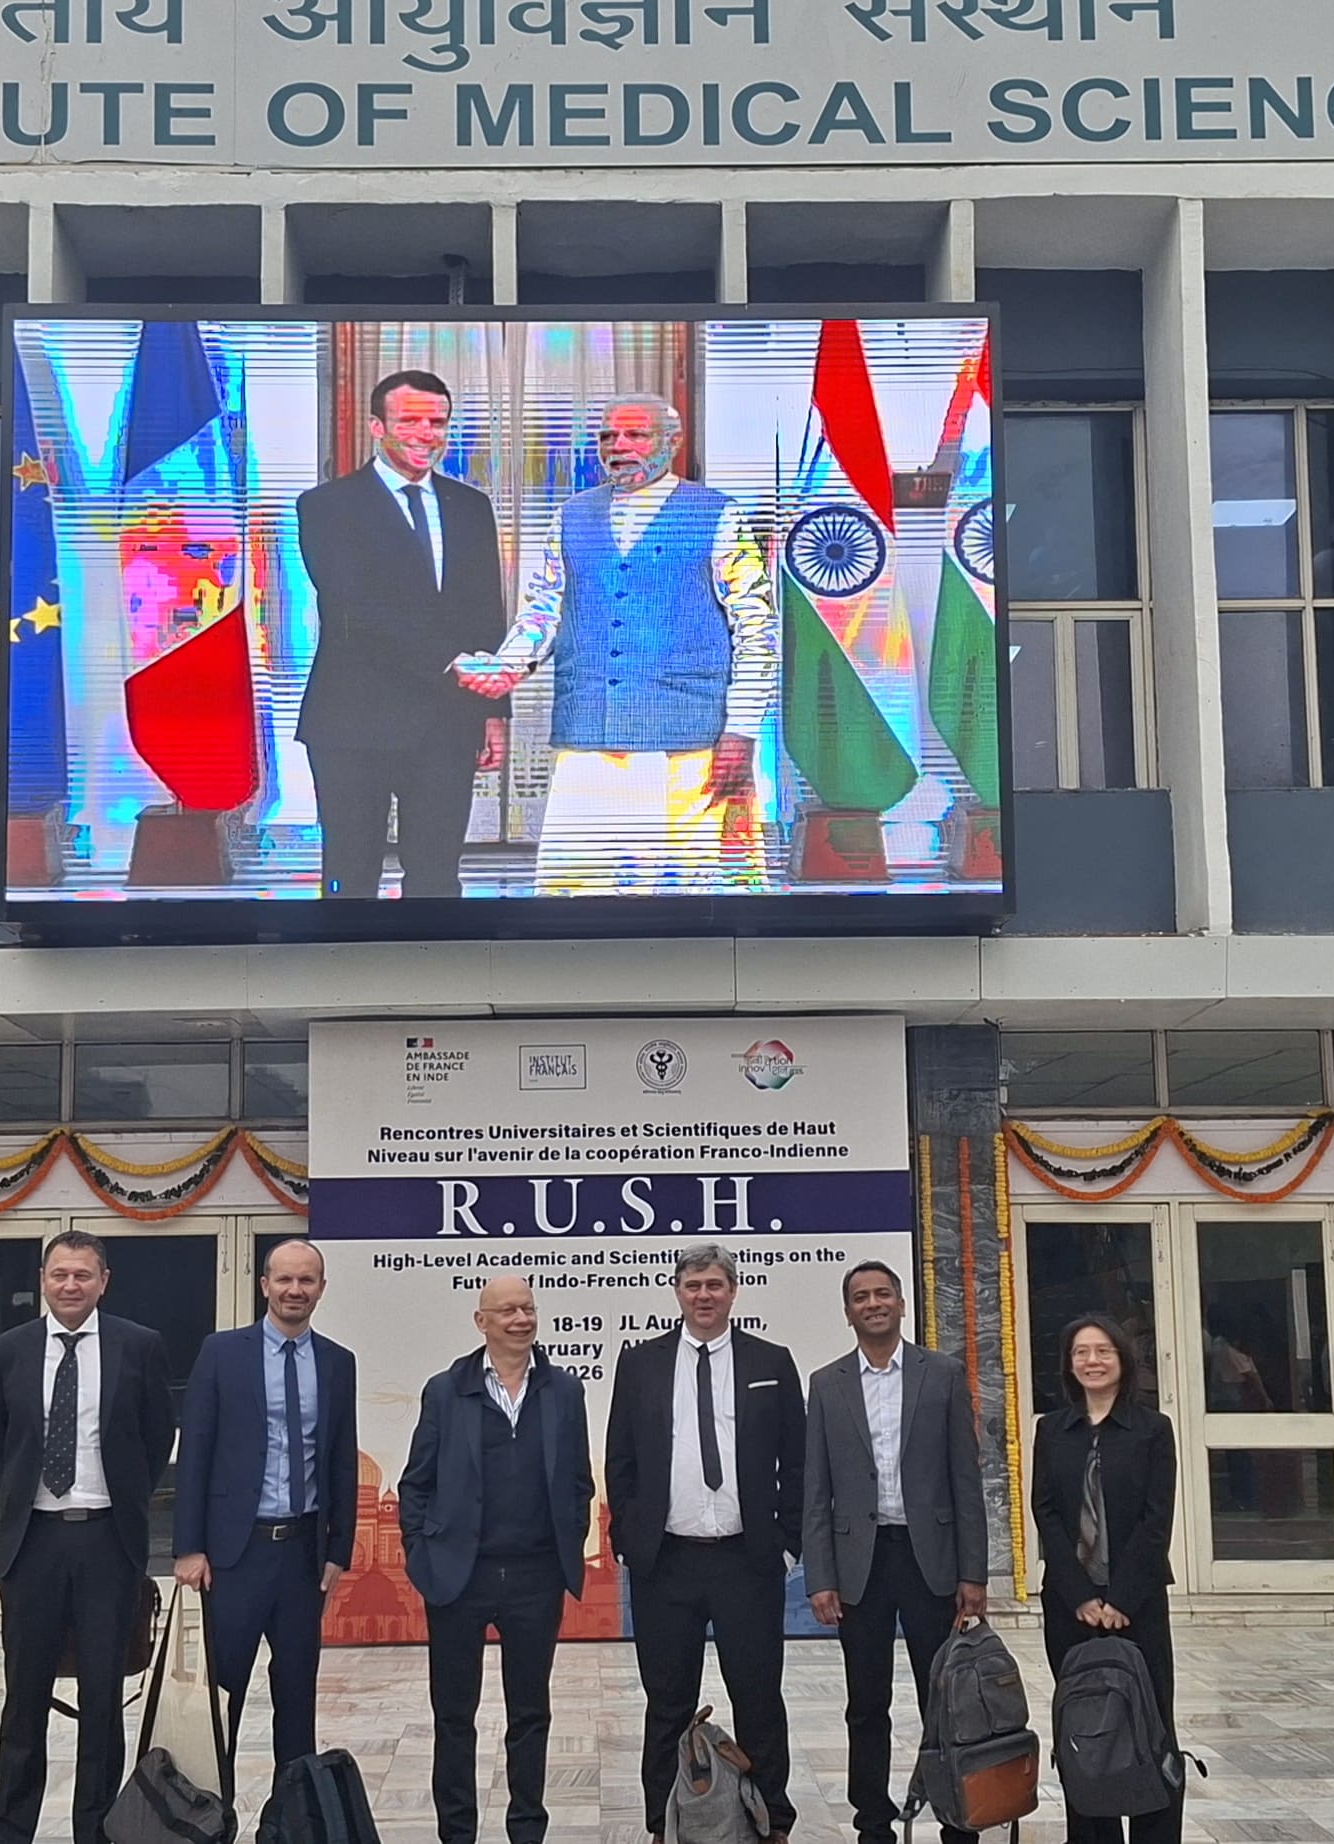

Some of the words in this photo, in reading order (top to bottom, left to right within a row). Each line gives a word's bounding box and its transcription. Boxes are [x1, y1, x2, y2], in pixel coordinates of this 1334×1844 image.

[267, 82, 412, 147] OF
[454, 82, 952, 147] MEDICAL
[406, 1052, 469, 1061] AMBASSADE
[529, 1055, 572, 1066] INSTITUT
[406, 1062, 420, 1071] DE
[423, 1062, 464, 1071] FRANCE
[529, 1063, 577, 1077] FRANÇAIS
[406, 1073, 420, 1081] EN
[423, 1073, 449, 1082] INDE
[380, 1126, 484, 1140] Rencontres
[489, 1124, 616, 1139] Universitaires
[620, 1124, 638, 1137] et
[643, 1122, 762, 1139] Scientifiques
[767, 1122, 788, 1135] de
[793, 1121, 835, 1135] Haut
[367, 1149, 430, 1162] Niveau
[434, 1152, 463, 1162] sur
[468, 1147, 534, 1161] l'avenir
[538, 1147, 560, 1160] de
[565, 1146, 581, 1160] la
[586, 1145, 695, 1163] coopération
[700, 1143, 849, 1159] Franco-Indienne
[436, 1176, 783, 1235] R.U.S.H.
[373, 1253, 471, 1271] High-Level
[476, 1252, 566, 1266] Academic
[571, 1251, 605, 1265] and
[610, 1250, 683, 1264] Scientif
[731, 1249, 785, 1266] etings
[789, 1252, 811, 1263] on
[817, 1248, 846, 1262] the
[539, 1272, 650, 1288] Indo-French
[553, 1316, 603, 1332] 18-19
[619, 1315, 640, 1330] JL
[535, 1340, 603, 1360] ruary
[566, 1365, 603, 1380] 026
